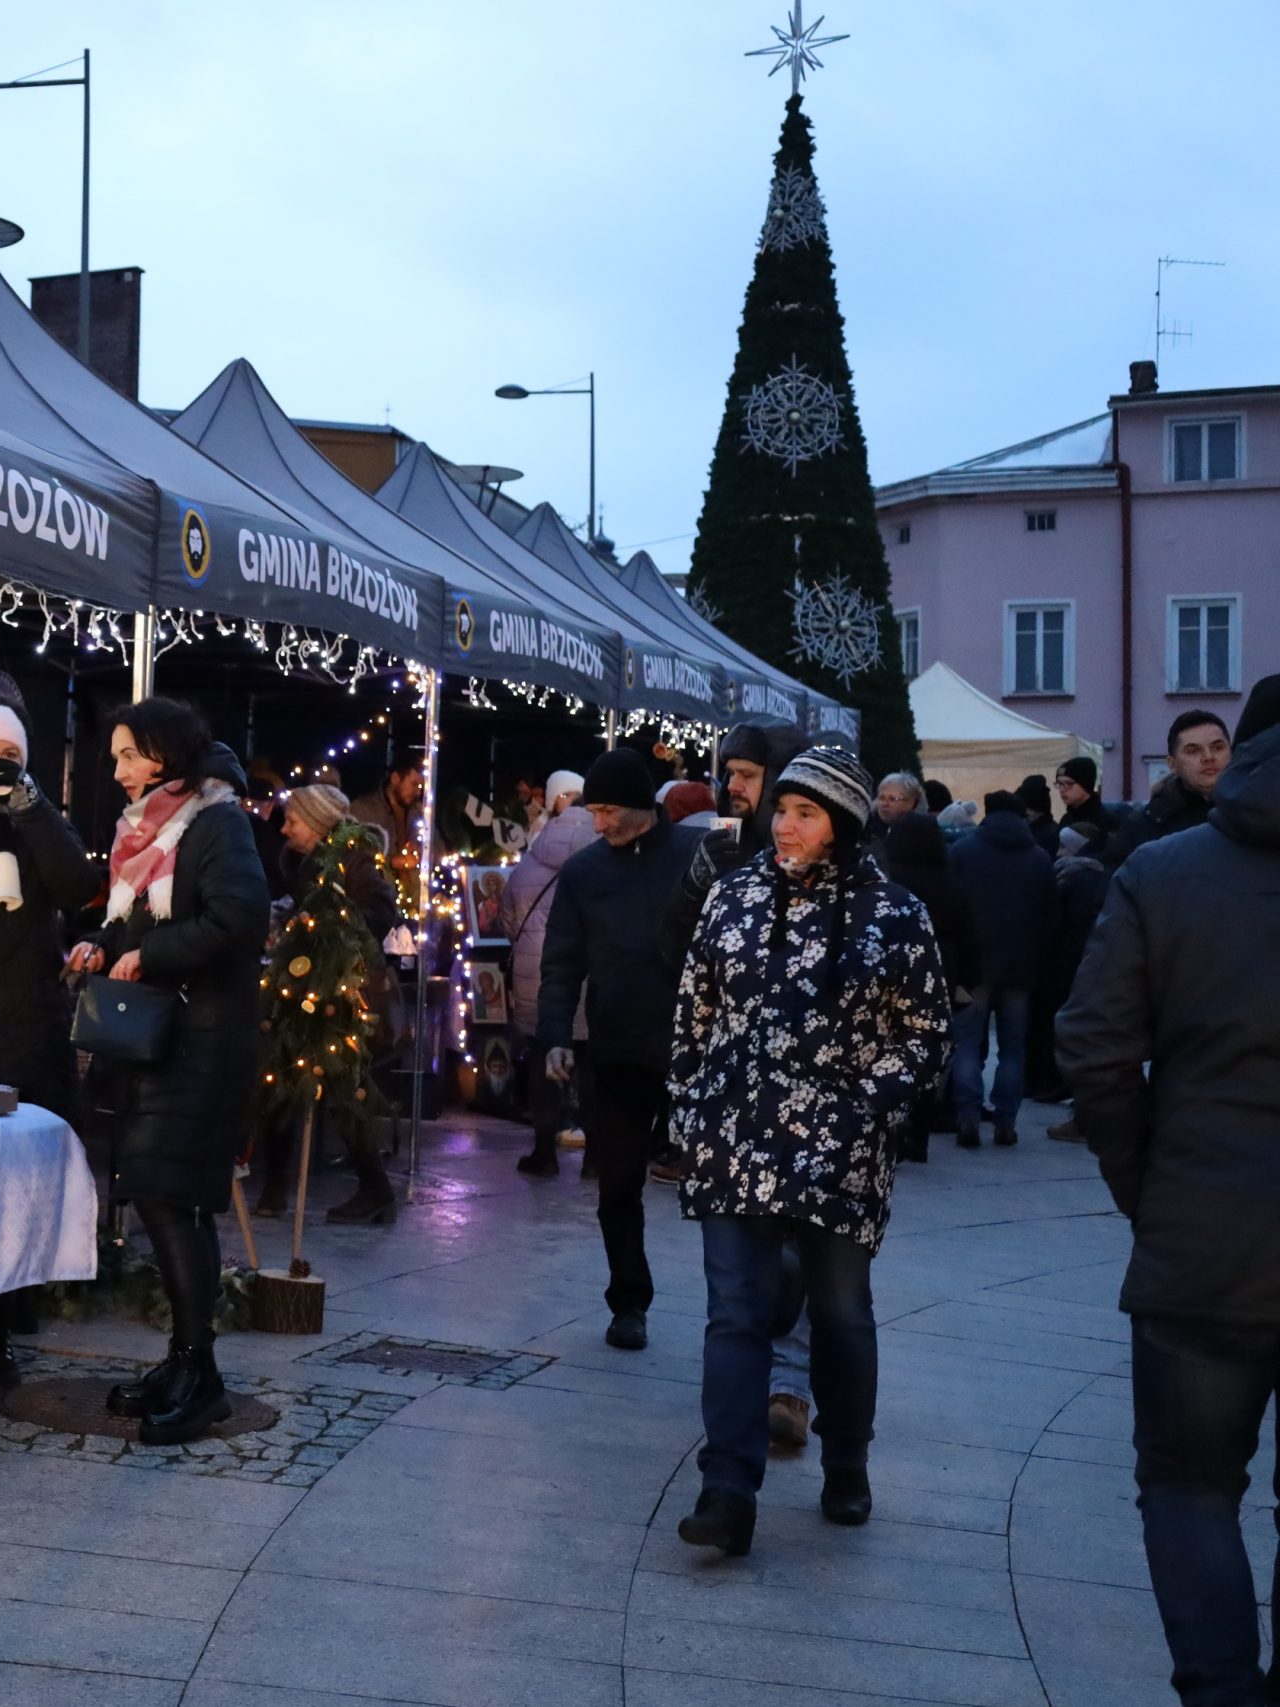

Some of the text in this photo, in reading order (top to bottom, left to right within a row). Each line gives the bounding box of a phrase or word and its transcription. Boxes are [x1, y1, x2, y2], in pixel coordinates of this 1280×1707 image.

[238, 528, 419, 631] GMINA BRZOZÓW
[489, 609, 604, 681] GMINA BRZOZÓW
[643, 654, 674, 691] GMINA
